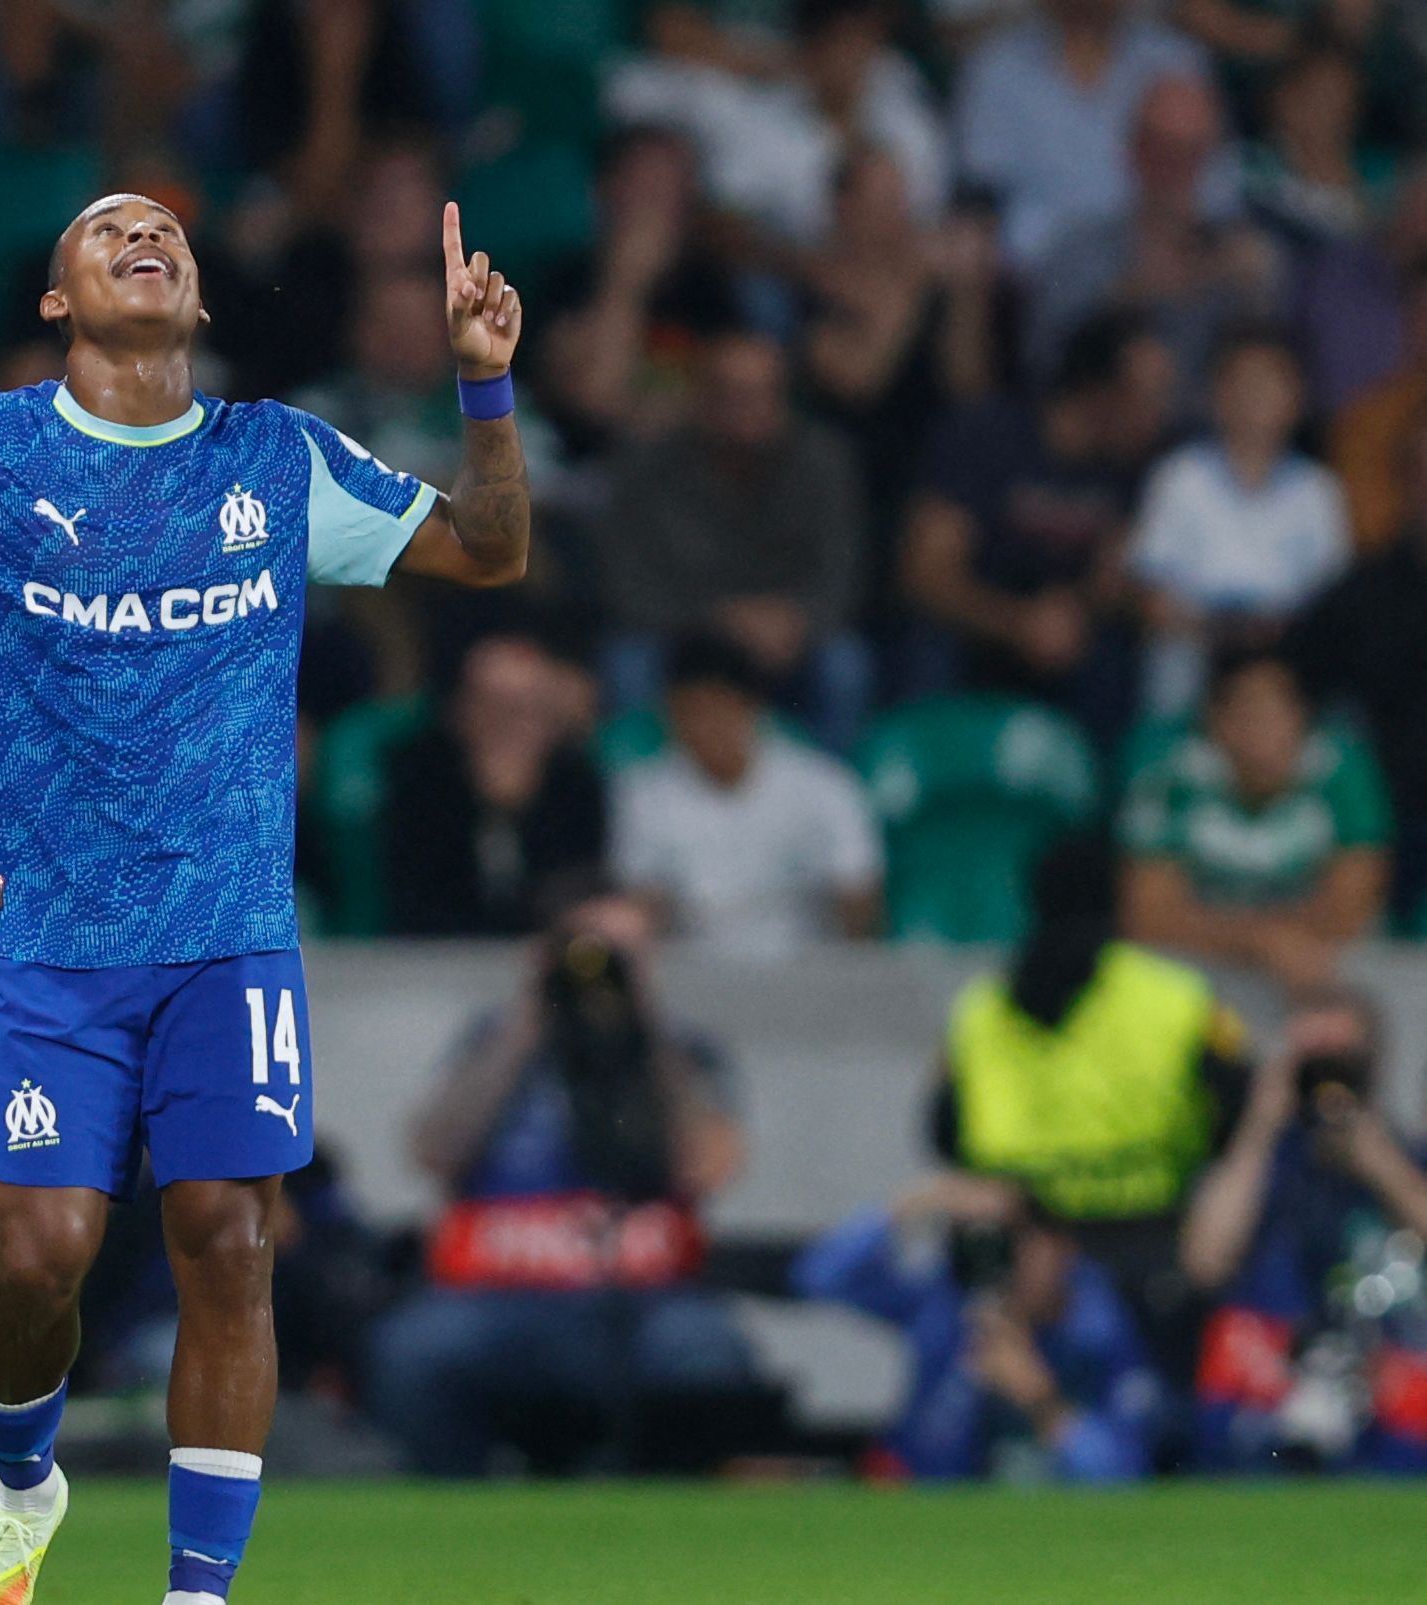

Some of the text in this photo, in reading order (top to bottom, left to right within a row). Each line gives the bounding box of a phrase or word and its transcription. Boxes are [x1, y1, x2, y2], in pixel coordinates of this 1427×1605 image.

[23, 567, 278, 633] CMA CGM
[245, 987, 301, 1085] 14
